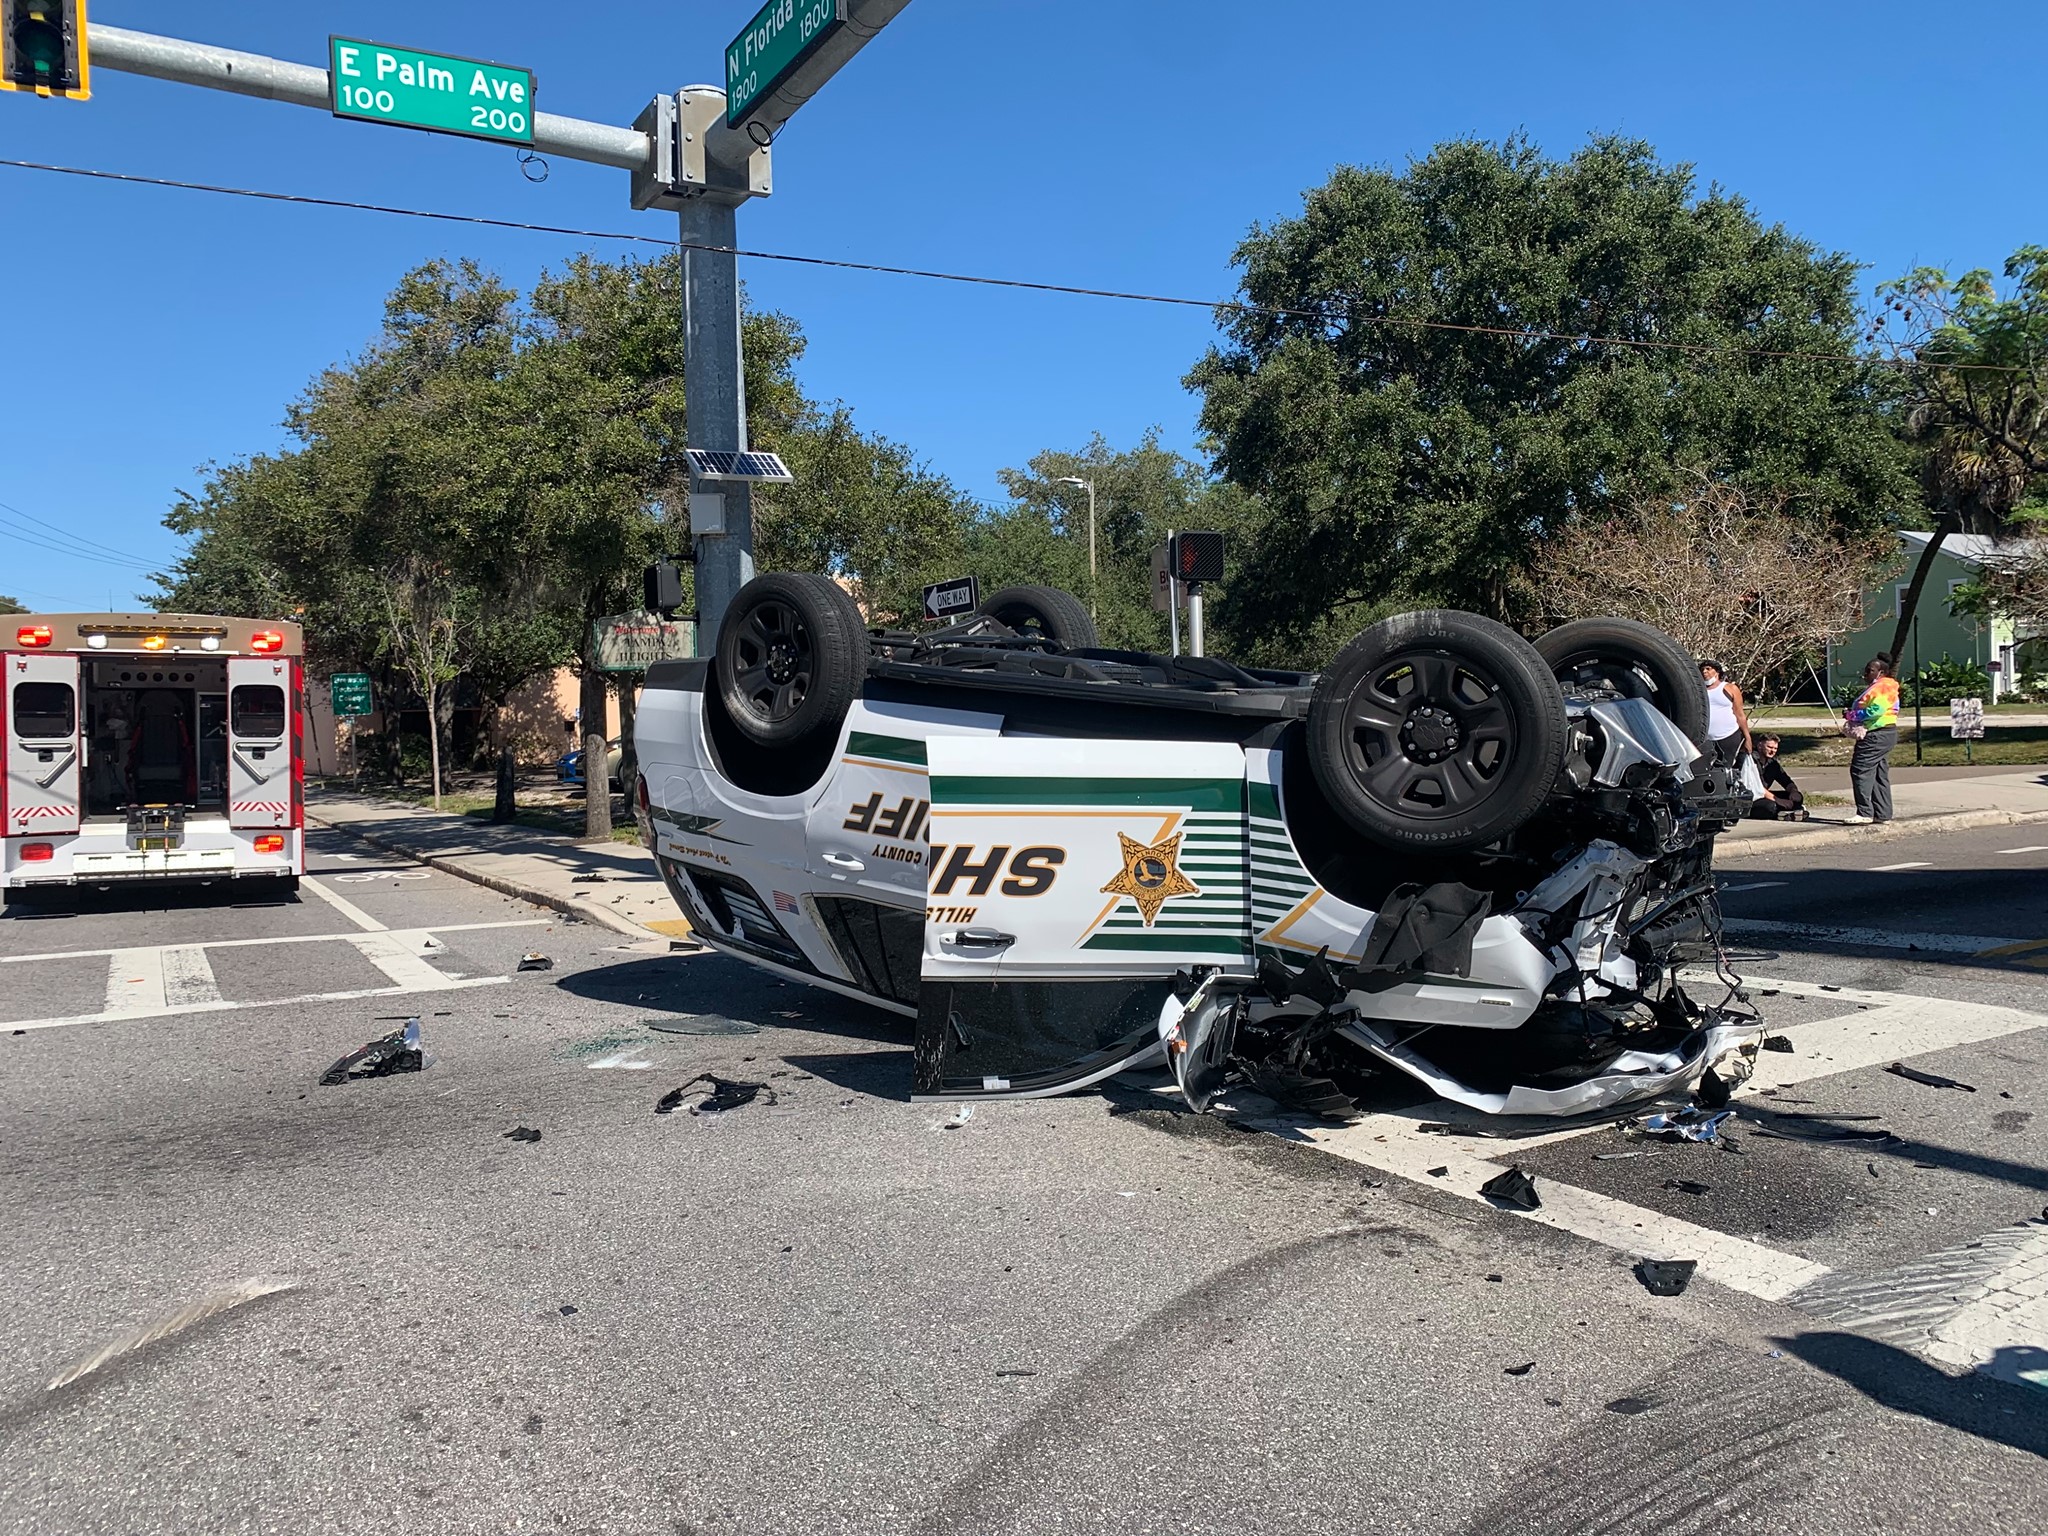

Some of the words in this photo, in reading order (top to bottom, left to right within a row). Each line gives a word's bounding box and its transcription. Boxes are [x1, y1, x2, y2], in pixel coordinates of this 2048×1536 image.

[800, 0, 830, 42] 1800
[729, 49, 739, 82] N
[744, 0, 794, 67] Florida
[339, 46, 361, 77] E
[376, 52, 455, 93] Palm
[469, 70, 525, 103] Ave
[342, 84, 395, 113] 100
[732, 70, 757, 111] 1900
[470, 105, 526, 133] 200
[937, 592, 952, 607] ONE
[952, 588, 967, 604] WAY
[624, 637, 666, 648] TAMPA
[620, 651, 673, 661] HEIGHTS
[1395, 826, 1473, 841] Firestone
[871, 843, 922, 865] COUNTY
[1136, 850, 1166, 861] COUNTY
